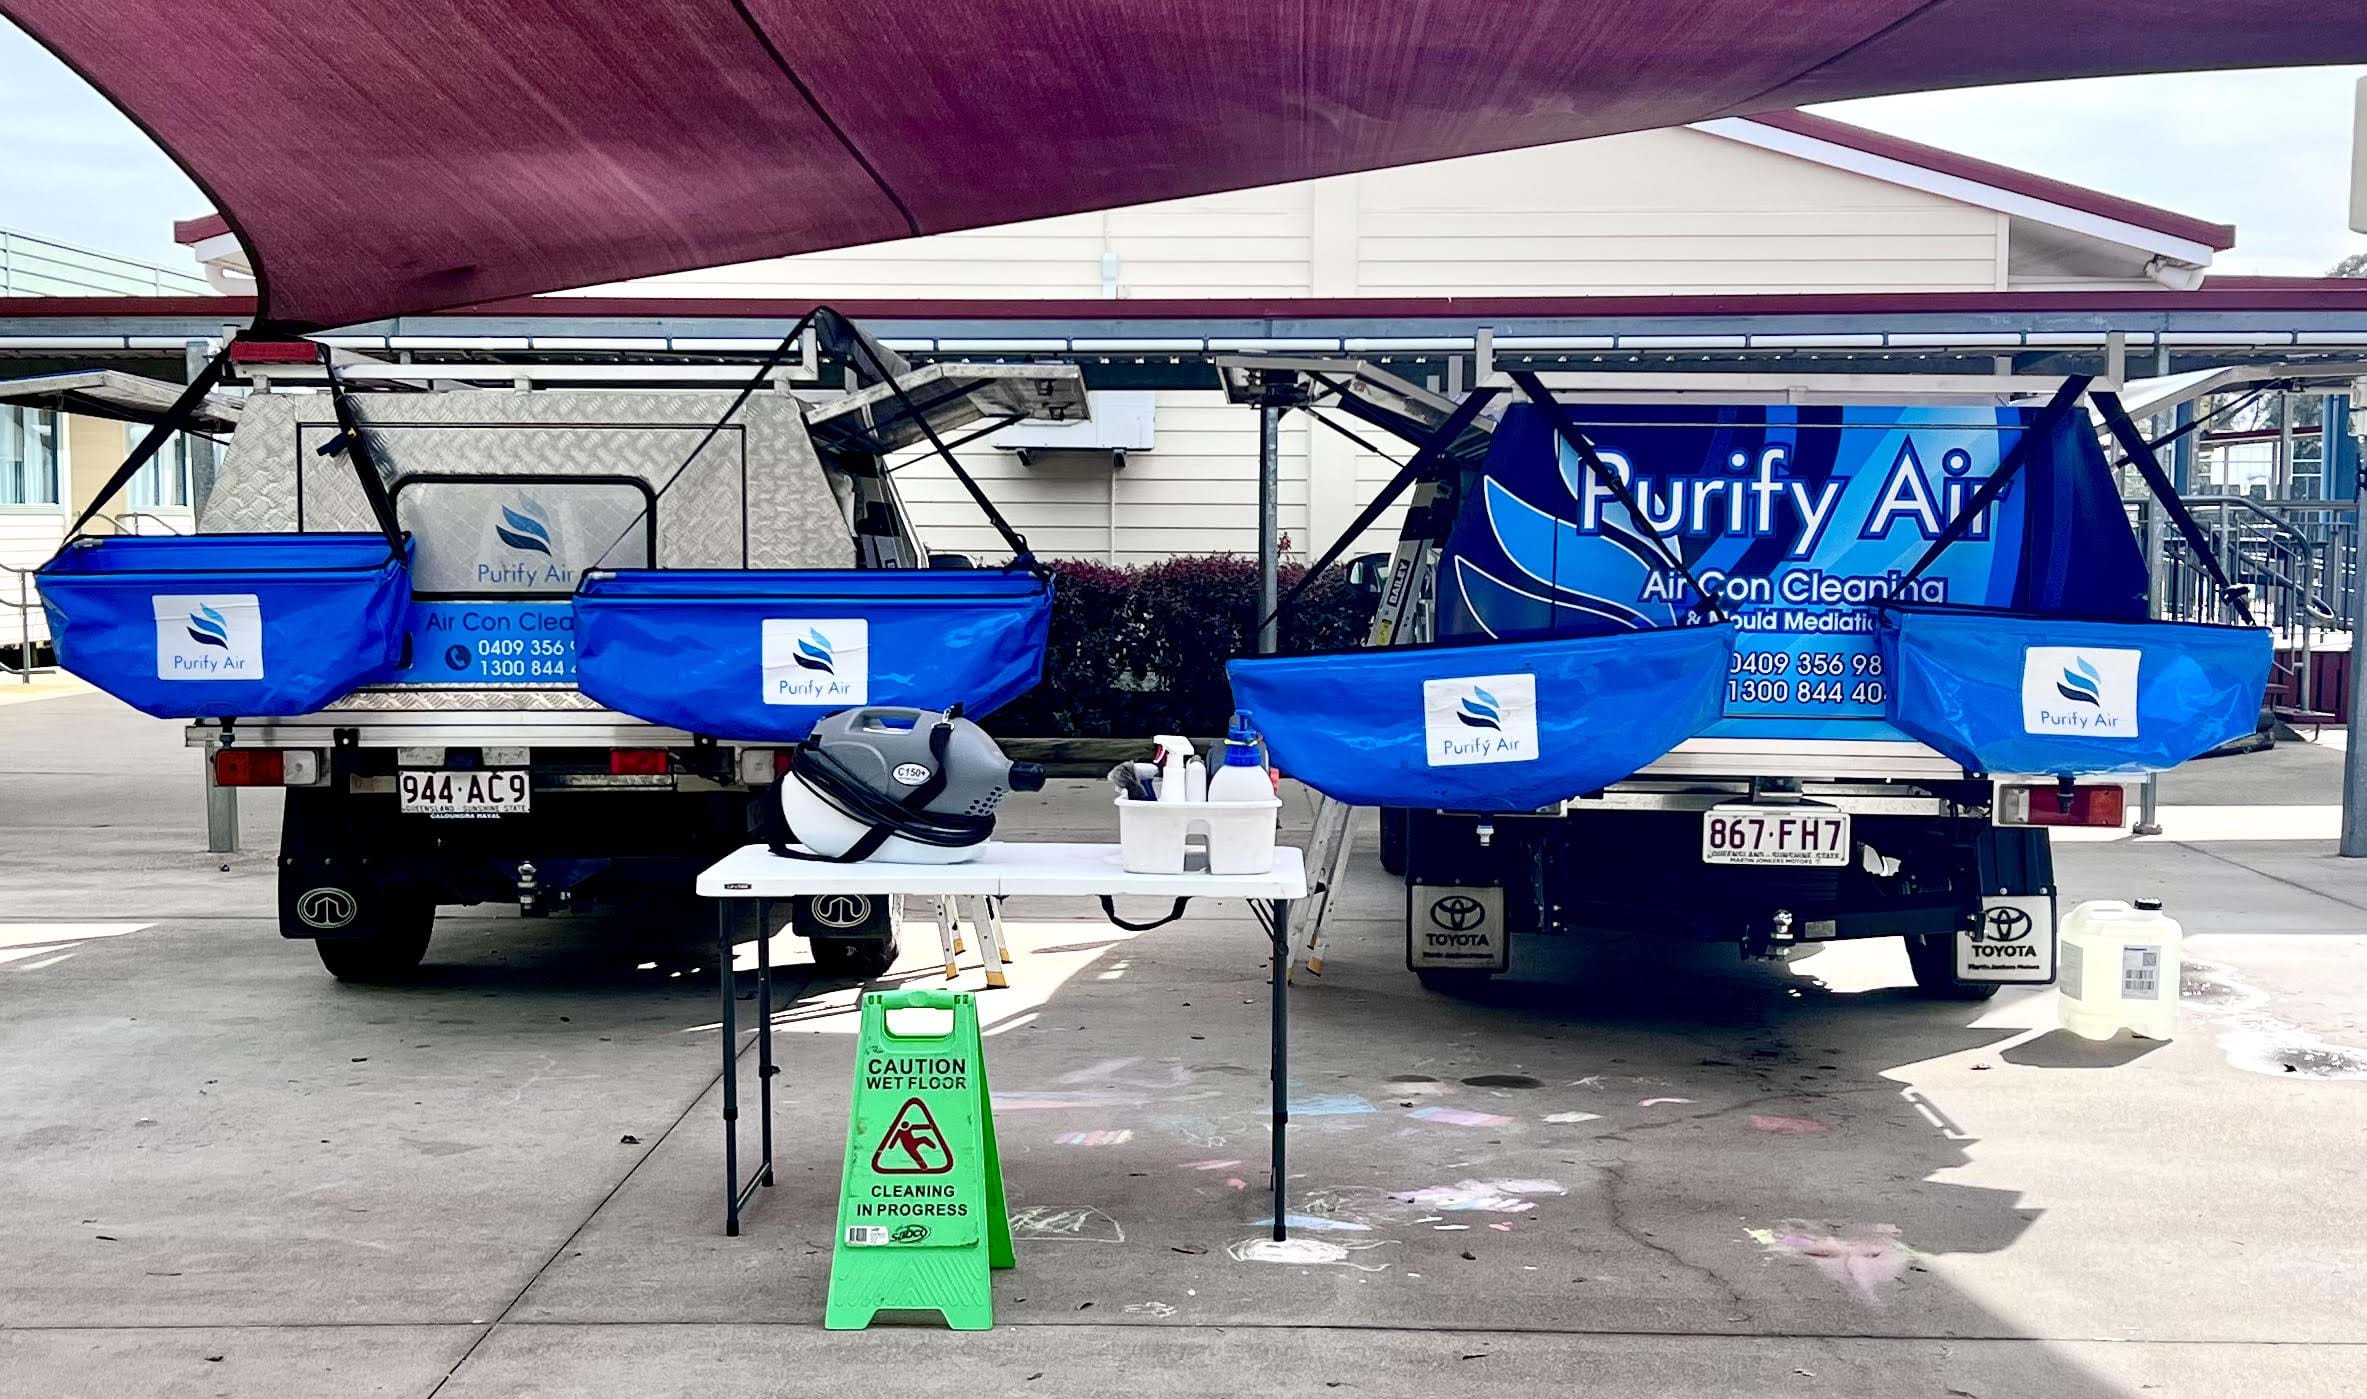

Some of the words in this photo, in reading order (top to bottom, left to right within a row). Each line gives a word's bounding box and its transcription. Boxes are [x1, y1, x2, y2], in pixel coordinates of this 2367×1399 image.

[1581, 444, 1845, 558] Purify
[1863, 442, 2012, 538] Air
[478, 563, 537, 587] Purify
[544, 563, 575, 583] Air
[1388, 560, 1408, 605] BAILEY
[1642, 570, 1688, 600] Air
[1698, 570, 1770, 601] Con
[425, 612, 455, 632] Air
[463, 612, 511, 632] Con
[478, 639, 524, 656] 0409
[530, 639, 565, 656] 356
[174, 654, 217, 673] Purify
[223, 656, 246, 670] Air
[480, 660, 525, 676] 1300
[531, 660, 565, 676] 844
[1797, 653, 1844, 675] 356
[779, 680, 823, 698] Purify
[828, 681, 851, 695] Air
[1729, 680, 1789, 702] 1300
[1797, 681, 1843, 703] 844
[1851, 682, 1887, 704] 40
[2040, 711, 2088, 729] Purify
[2095, 713, 2119, 727] Air
[1443, 738, 1491, 757] Purify
[1496, 738, 1520, 752] Air
[1711, 850, 1765, 858] QUEENSLAND
[1425, 933, 1490, 947] TOYOTA
[1971, 944, 2037, 957] TOYOTA
[868, 1058, 966, 1075] CAUTION
[866, 1076, 904, 1090] WET
[908, 1076, 967, 1090] FLOOR
[871, 1184, 956, 1198] CLEANING
[857, 1203, 873, 1216] IN
[877, 1203, 968, 1216] PROGRESS
